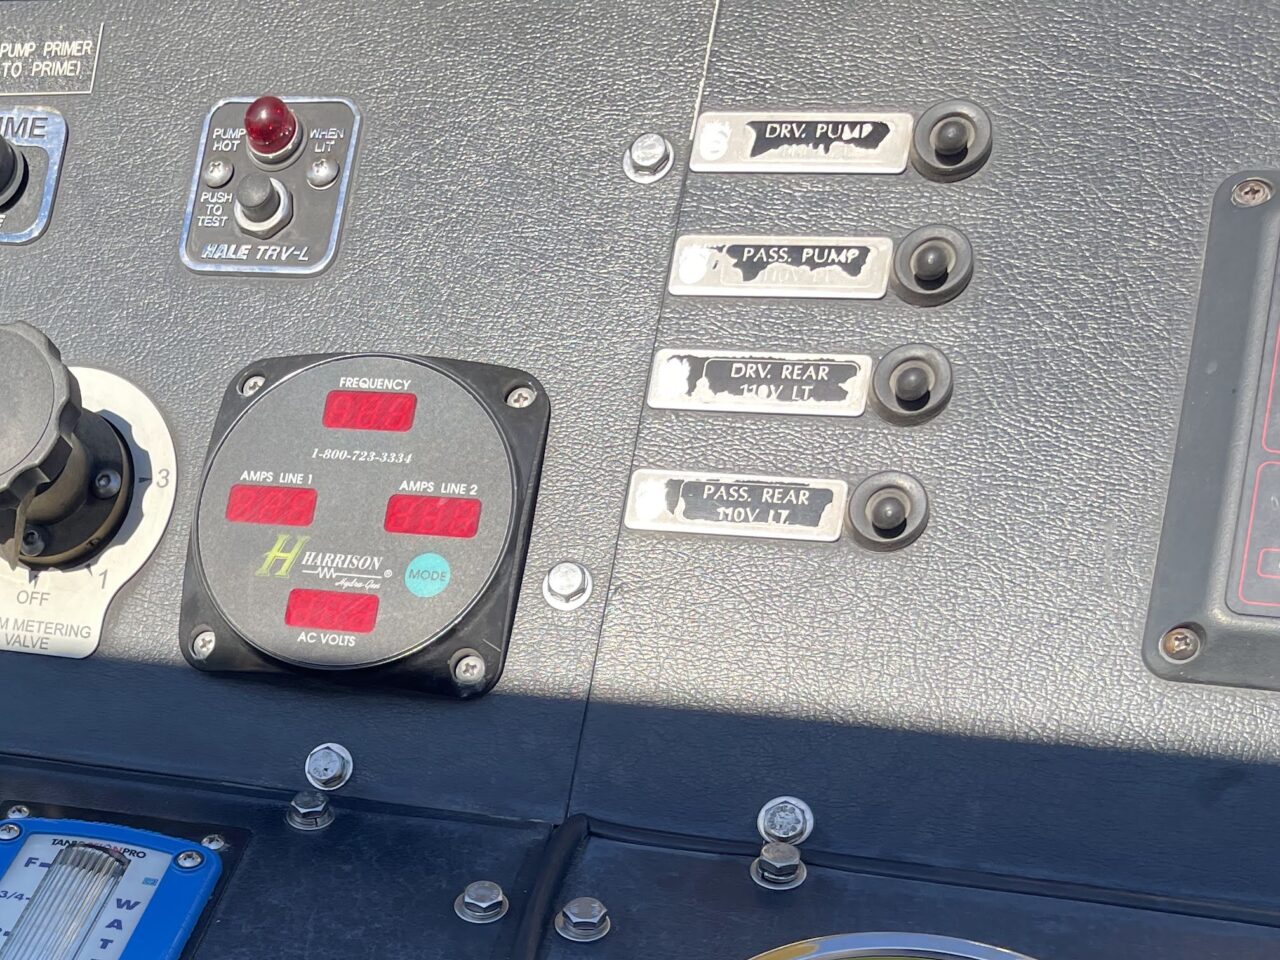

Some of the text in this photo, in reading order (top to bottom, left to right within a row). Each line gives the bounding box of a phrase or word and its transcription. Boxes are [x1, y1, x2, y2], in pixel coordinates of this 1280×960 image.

[0, 42, 35, 57] PUMP
[43, 40, 93, 57] PRIMER
[3, 62, 22, 78] TO
[31, 60, 81, 77] PRIME)
[212, 128, 246, 139] PUMP
[309, 128, 345, 139] WHEN
[765, 123, 873, 141] DRV. PUMP
[212, 140, 241, 151] HOT
[314, 141, 335, 152] LIT
[200, 191, 232, 203] PUSH
[205, 204, 223, 216] TO
[197, 215, 228, 227] TEST
[200, 243, 310, 262] HALE TRV-L
[742, 247, 860, 264] PASS. PUMP
[730, 362, 830, 381] DRV. REAR
[339, 377, 411, 391] FREQUENCY
[311, 447, 413, 464] 1-800-723-3334
[156, 468, 170, 489] 3
[240, 470, 313, 485] AMPS LINE 1
[398, 480, 478, 495] AMPS LINE 2
[703, 484, 810, 505] PASS. REAR
[716, 506, 760, 522] 110V
[254, 534, 311, 578] H
[301, 551, 384, 571] HARRISON
[97, 569, 109, 590] 1
[408, 569, 447, 582] MODE
[16, 589, 51, 607] OFF
[12, 617, 93, 639] METERING
[4, 633, 50, 650] VALVE
[297, 631, 356, 647] AC VOLTS
[24, 856, 39, 868] F
